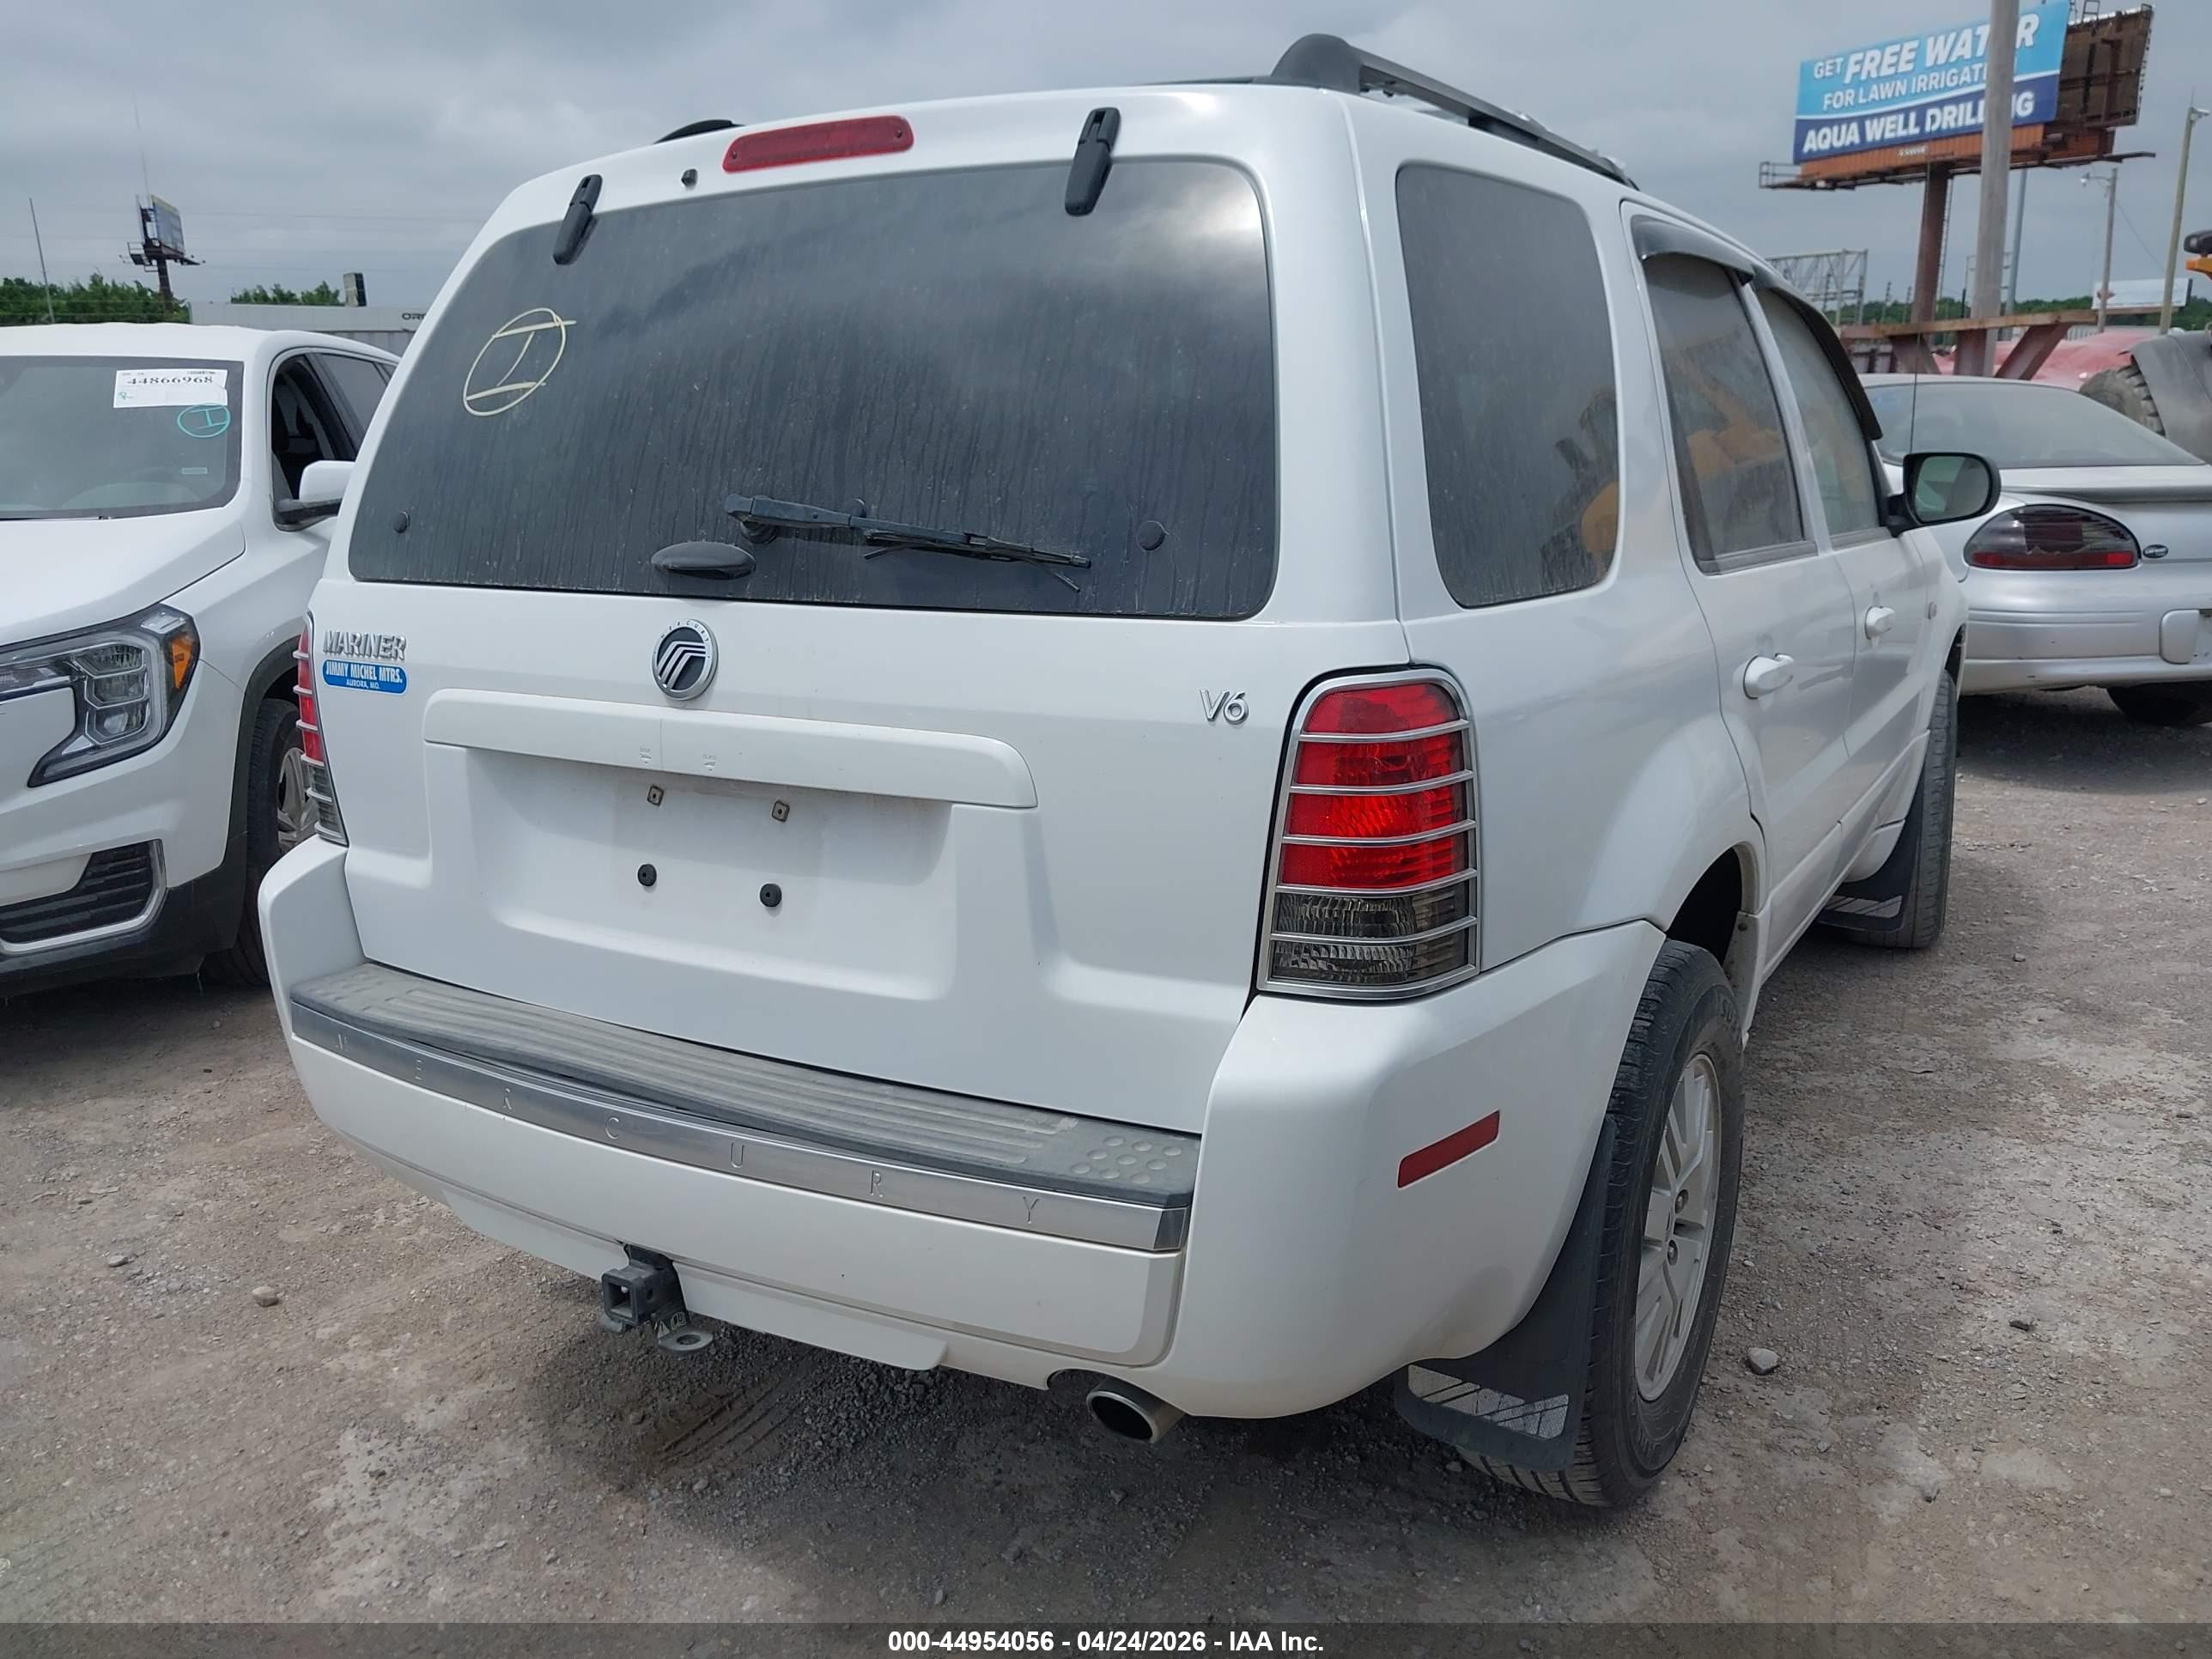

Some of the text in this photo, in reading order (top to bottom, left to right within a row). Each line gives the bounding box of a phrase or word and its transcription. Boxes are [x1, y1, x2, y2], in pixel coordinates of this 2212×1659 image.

[1814, 13, 2039, 83] GET FREE WATR
[1823, 89, 1854, 111] FOR
[1859, 80, 1906, 104] LAWN
[1802, 122, 1860, 153] AQUA
[1865, 112, 1920, 142] WELL
[322, 629, 407, 660] MARINER
[325, 660, 403, 684] JIMMY MICHEL MTRS.
[1200, 690, 1249, 725] V6
